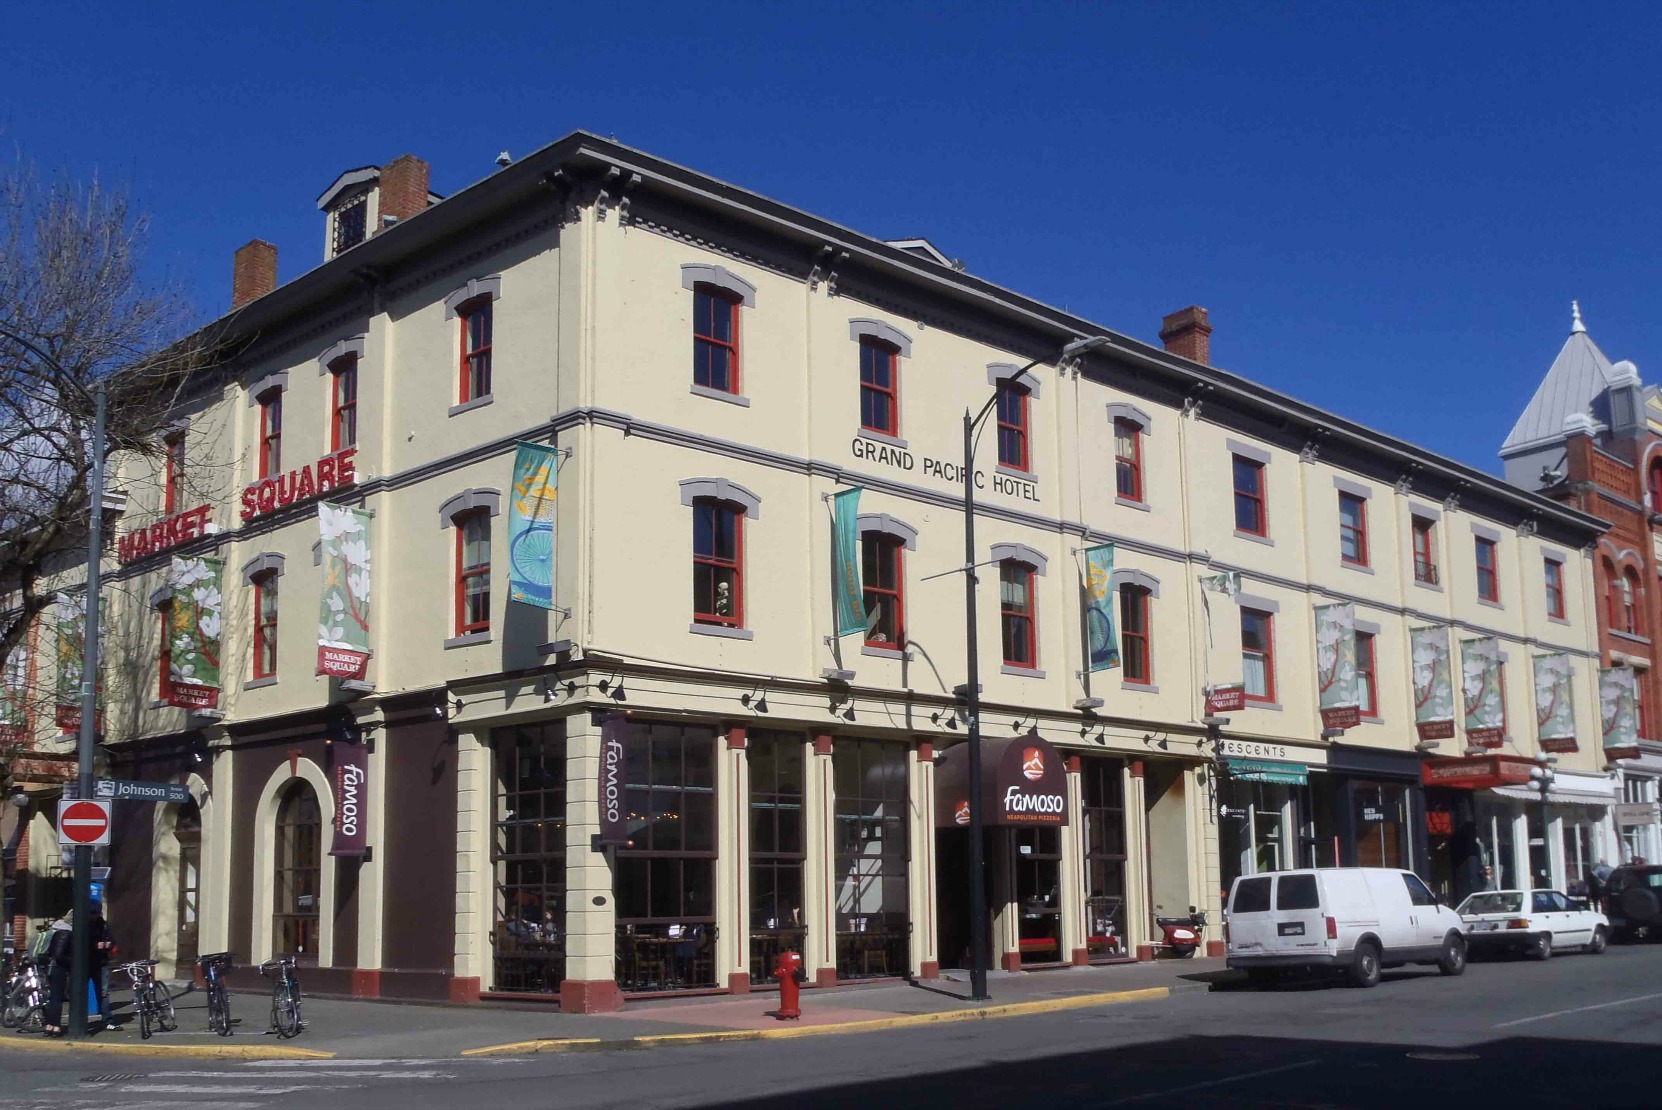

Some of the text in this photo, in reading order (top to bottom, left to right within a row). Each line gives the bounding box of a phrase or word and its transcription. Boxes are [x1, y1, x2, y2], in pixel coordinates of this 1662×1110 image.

[852, 438, 1040, 502] GRAND PACIFC HOTEL
[118, 447, 358, 565] MARKET SQUARE
[324, 651, 362, 665] MARKET
[176, 687, 210, 698] MARKET
[174, 694, 209, 706] SQUARE
[1227, 743, 1286, 757] ESCENTS
[118, 782, 165, 797] Johnson
[169, 792, 184, 800] 500
